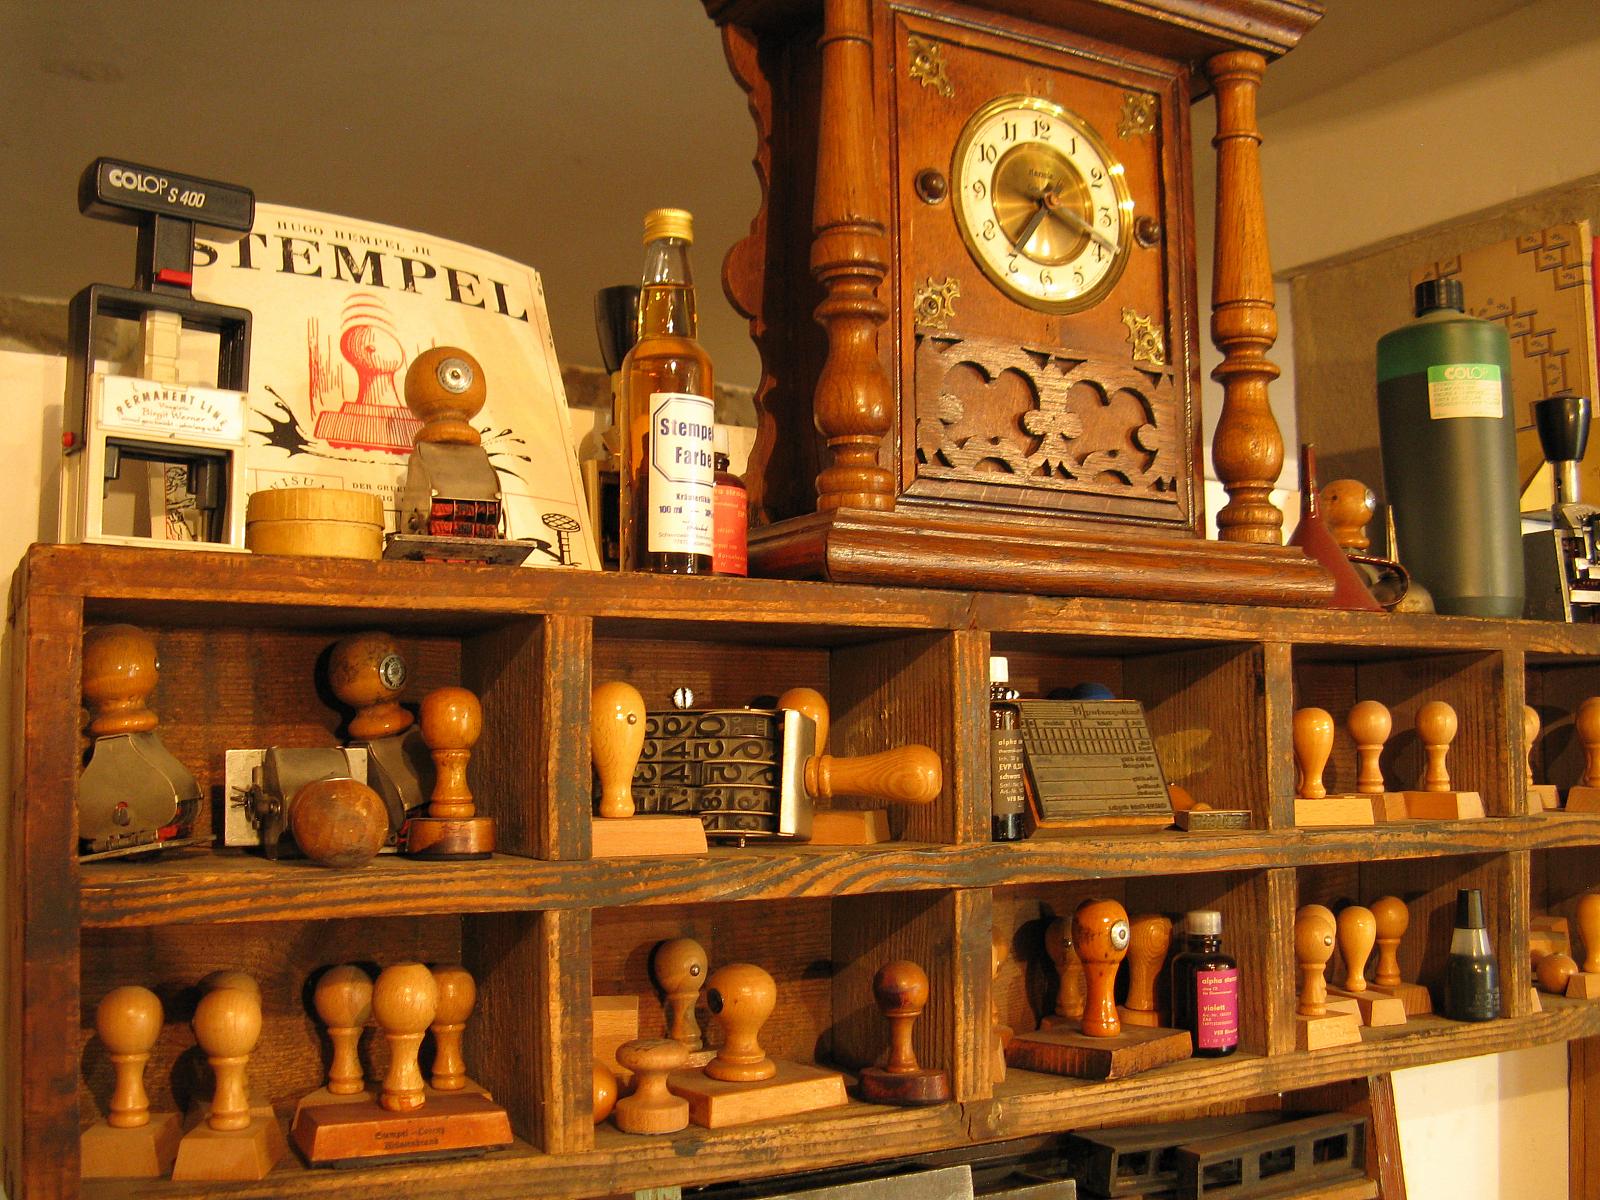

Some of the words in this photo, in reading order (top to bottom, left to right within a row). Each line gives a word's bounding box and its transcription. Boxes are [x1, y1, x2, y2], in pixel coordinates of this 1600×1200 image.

[1001, 121, 1017, 142] 11
[1032, 118, 1050, 141] 12
[978, 143, 997, 164] 10
[1069, 136, 1077, 155] 1
[109, 168, 168, 196] COLOP
[1090, 167, 1103, 188] 2
[167, 187, 179, 204] S
[180, 190, 205, 208] 400
[973, 179, 986, 200] 9
[1099, 206, 1112, 227] 3
[277, 220, 323, 236] HUGO
[335, 230, 405, 252] HEMPEL
[982, 219, 996, 241] 8
[1092, 239, 1105, 263] 4
[1007, 251, 1019, 274] 7
[1039, 267, 1053, 286] 6
[116, 390, 196, 416] PERMANENT
[201, 400, 230, 427] LINE
[675, 446, 712, 469] Farbe
[352, 482, 372, 490] DER
[1202, 977, 1222, 985] alpha
[1203, 1004, 1225, 1012] violett
